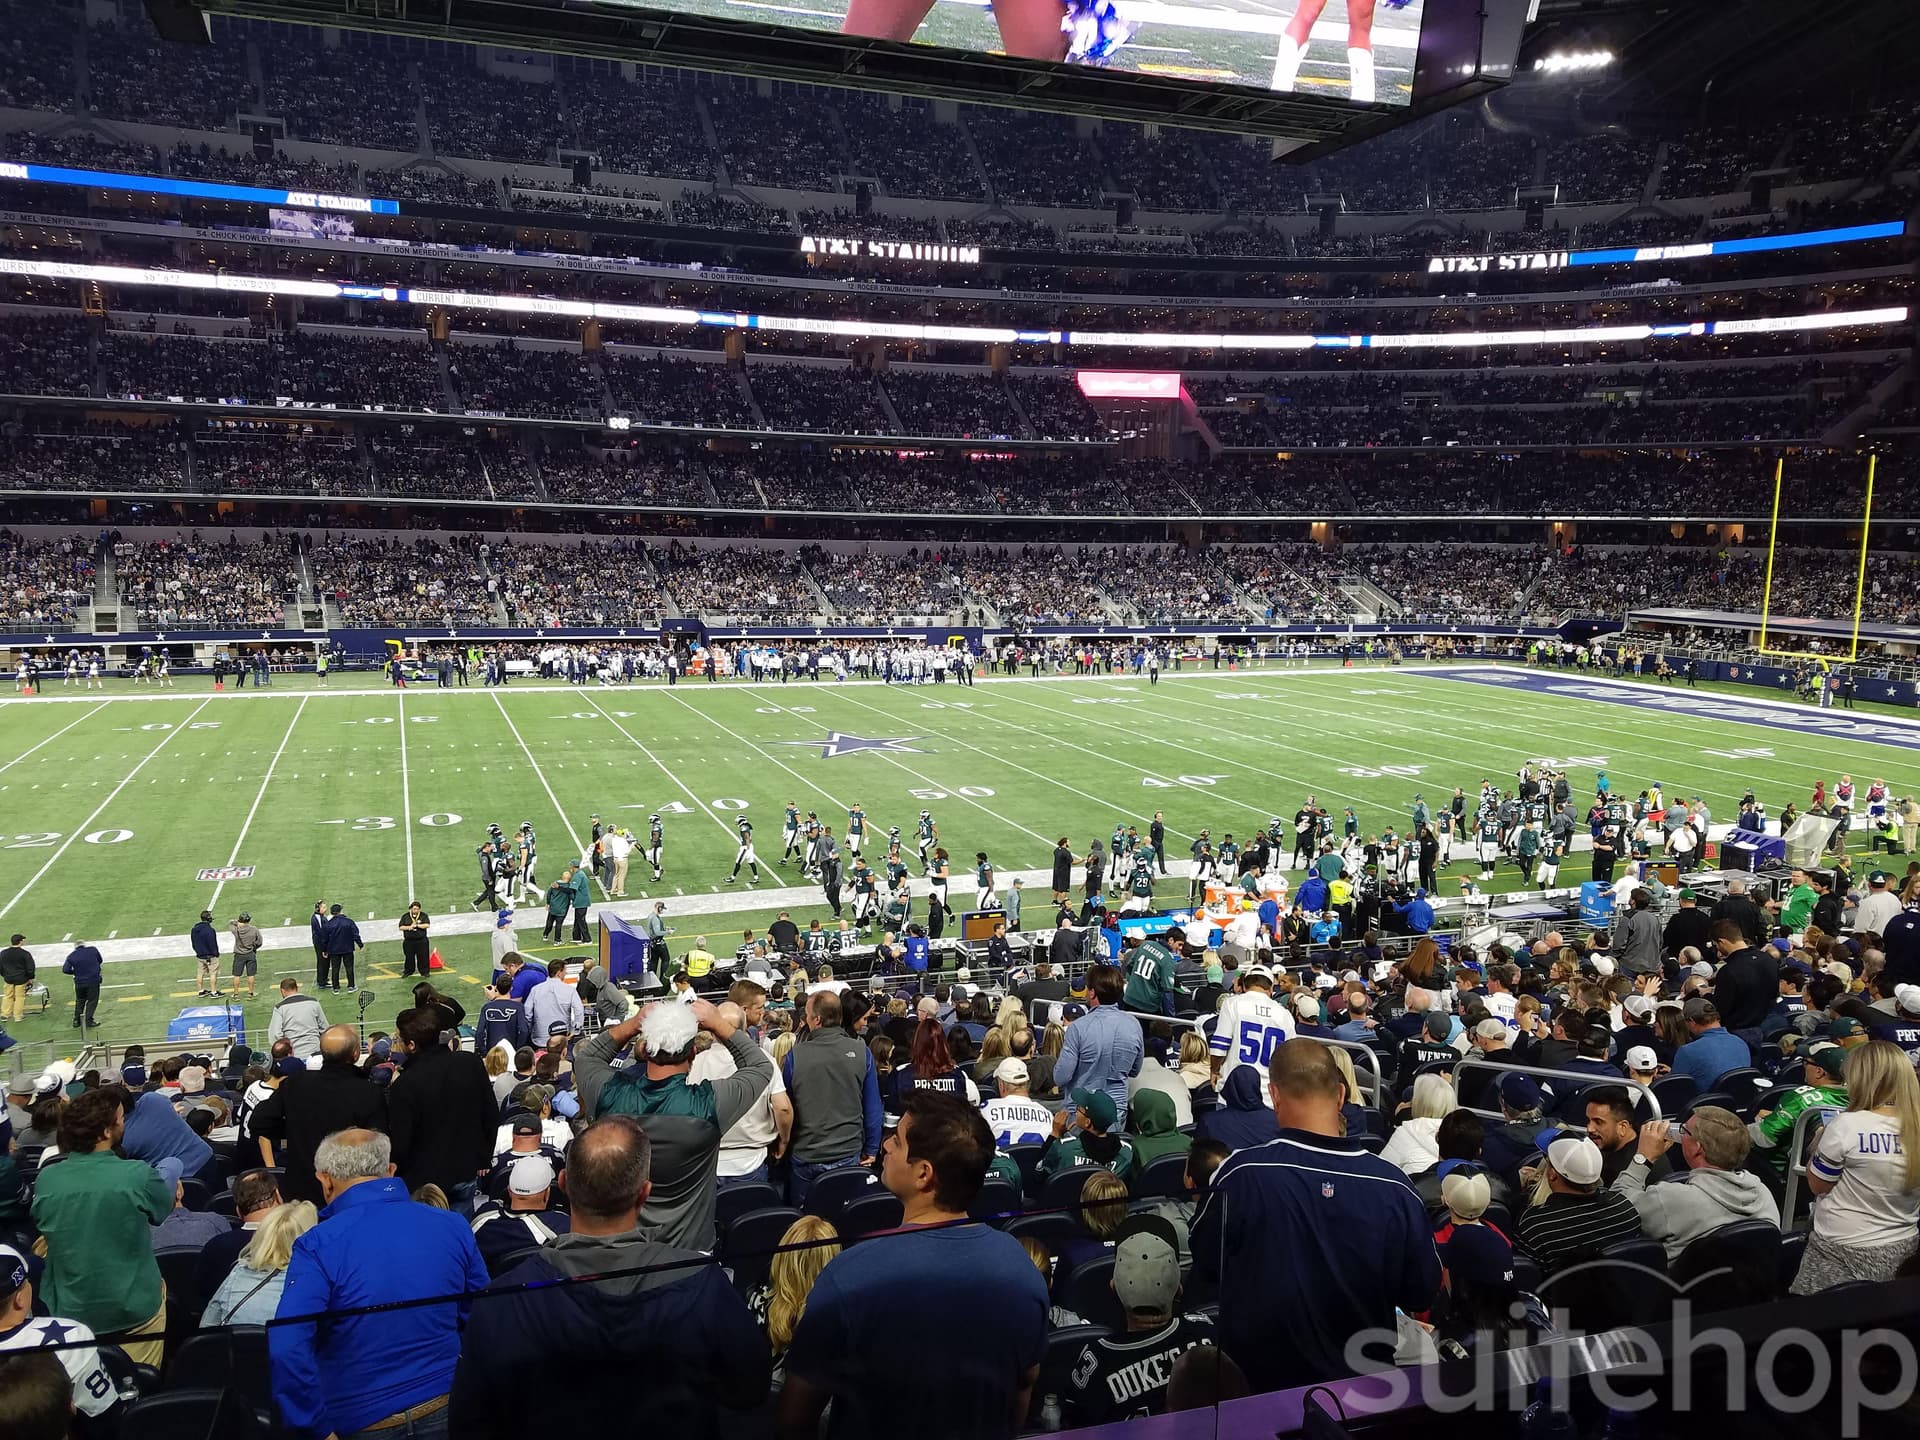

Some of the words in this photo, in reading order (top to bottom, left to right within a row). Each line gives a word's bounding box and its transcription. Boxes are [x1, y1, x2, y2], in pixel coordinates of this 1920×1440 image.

[3, 212, 16, 221] 20
[20, 214, 37, 222] MEL
[40, 216, 76, 226] RENFRO
[210, 231, 237, 240] CHUCK
[239, 233, 272, 243] HOWLEY
[383, 245, 389, 253] 17
[394, 246, 410, 255] DON
[412, 248, 450, 258] MEREDITH
[802, 236, 863, 256] AT&T
[567, 261, 583, 269] BOB
[584, 262, 602, 270] LILLY
[1428, 255, 1495, 273] AT&T
[727, 274, 754, 283] PERKINS
[880, 285, 911, 294] STAUBACH
[1612, 289, 1635, 297] DREW
[1636, 287, 1674, 296] PEARSON
[416, 291, 455, 305] CURRENT
[462, 294, 499, 307] JACKPOT
[1036, 293, 1060, 301] JORDAN
[1467, 295, 1504, 304] SCHRAMM
[907, 786, 996, 800] 50
[657, 798, 750, 815] 40
[1532, 808, 1545, 819] 82
[351, 813, 463, 831] 30
[1485, 825, 1498, 836] 97
[3, 829, 135, 849] 20
[204, 871, 246, 881] NFL
[1136, 876, 1148, 889] 29
[809, 936, 826, 951] 79
[841, 935, 858, 950] 65
[1143, 943, 1164, 960] JACKSON
[1134, 954, 1156, 980] 10
[1255, 1004, 1272, 1018] LEE
[1238, 1020, 1286, 1068] 50
[990, 1106, 1052, 1124] STAUBACH
[1857, 1132, 1904, 1155] LOVE
[1074, 1155, 1117, 1172] WEZ
